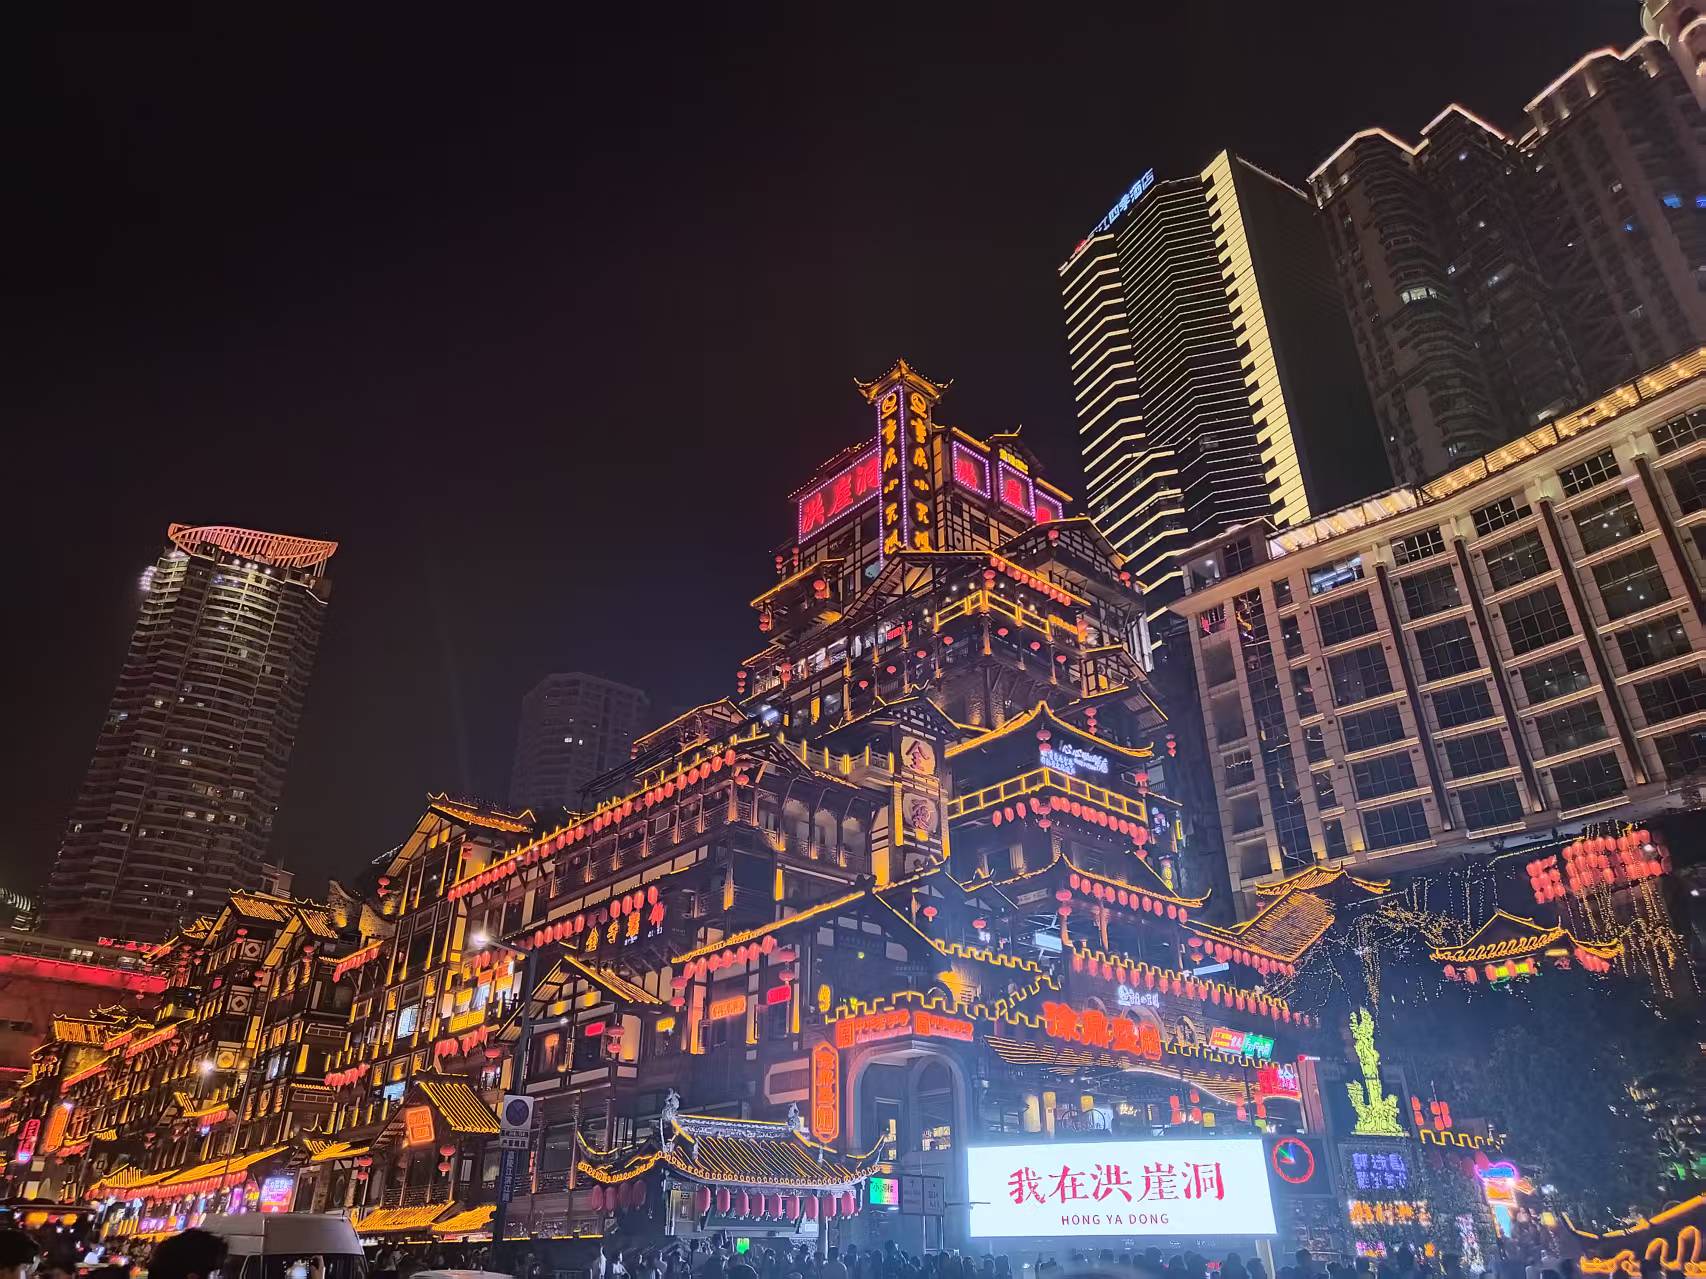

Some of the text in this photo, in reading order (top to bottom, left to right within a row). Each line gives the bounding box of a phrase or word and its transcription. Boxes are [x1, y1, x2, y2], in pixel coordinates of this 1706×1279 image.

[801, 455, 880, 533] 洪崖洞
[1008, 1161, 1225, 1204] 我在洪崖洞
[1062, 1213, 1169, 1225] HONG YA DONG
